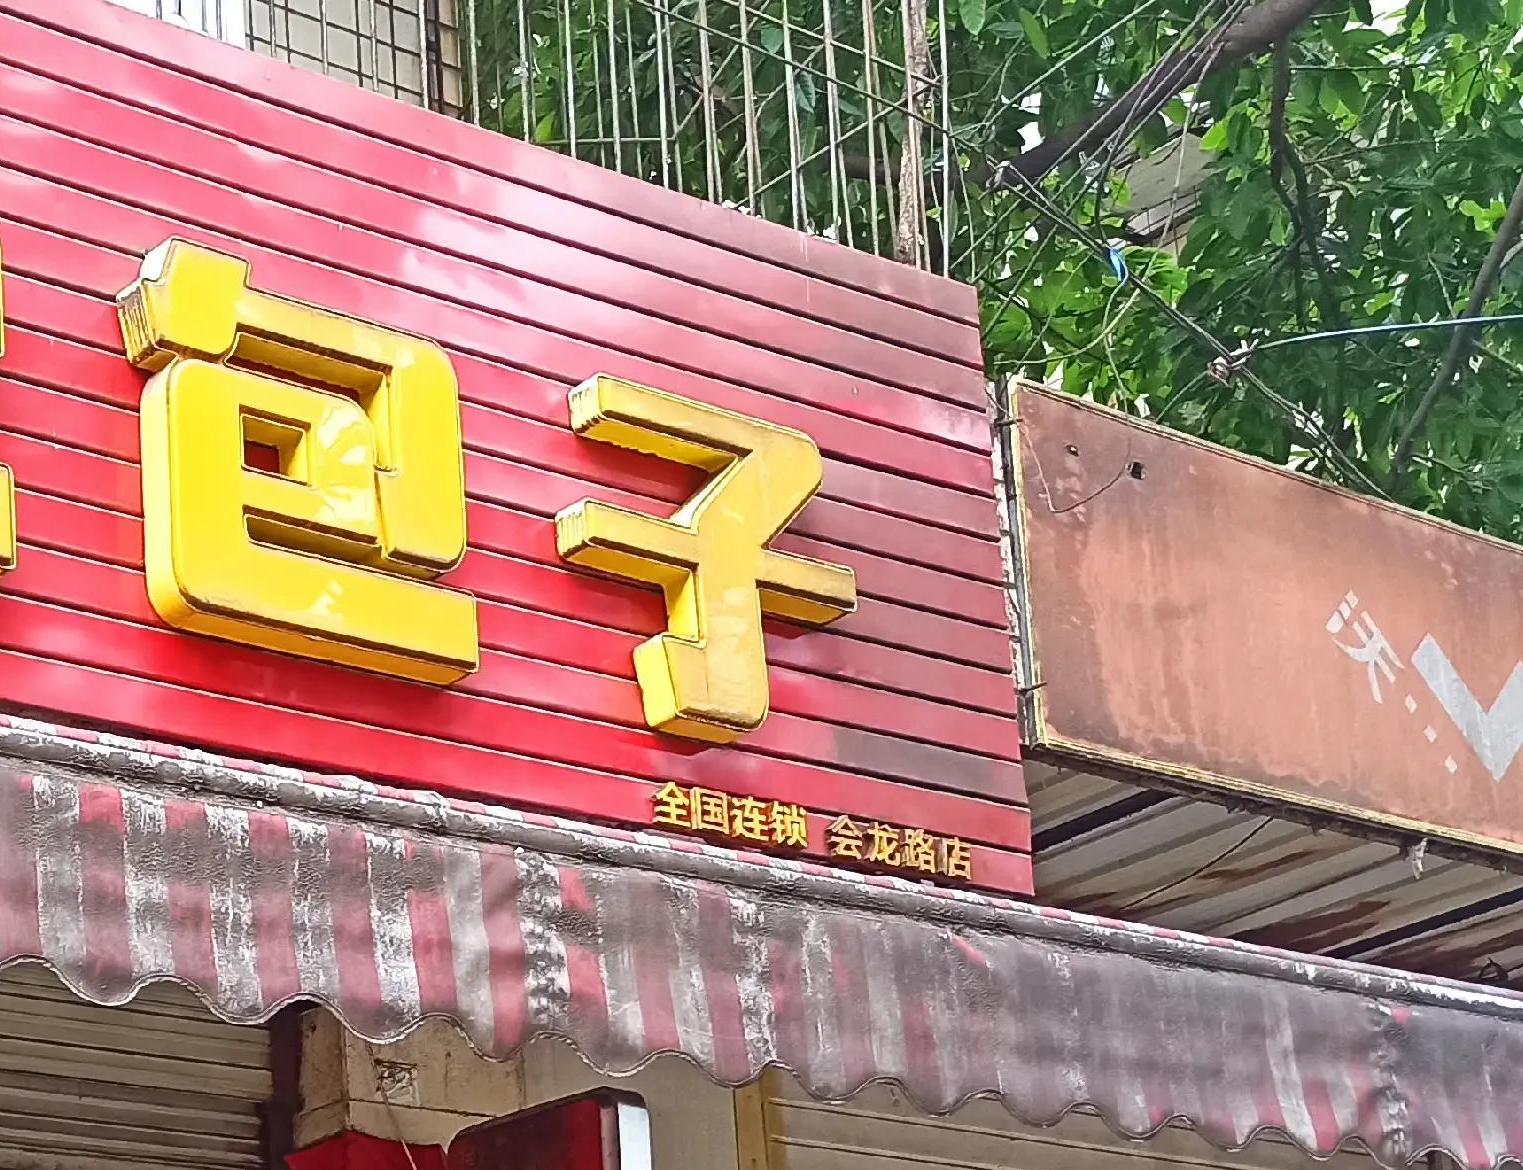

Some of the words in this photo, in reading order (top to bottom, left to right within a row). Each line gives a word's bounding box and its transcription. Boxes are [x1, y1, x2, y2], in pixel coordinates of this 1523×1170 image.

[651, 781, 809, 849] 全国连锁
[827, 814, 973, 881] 会龙路店
